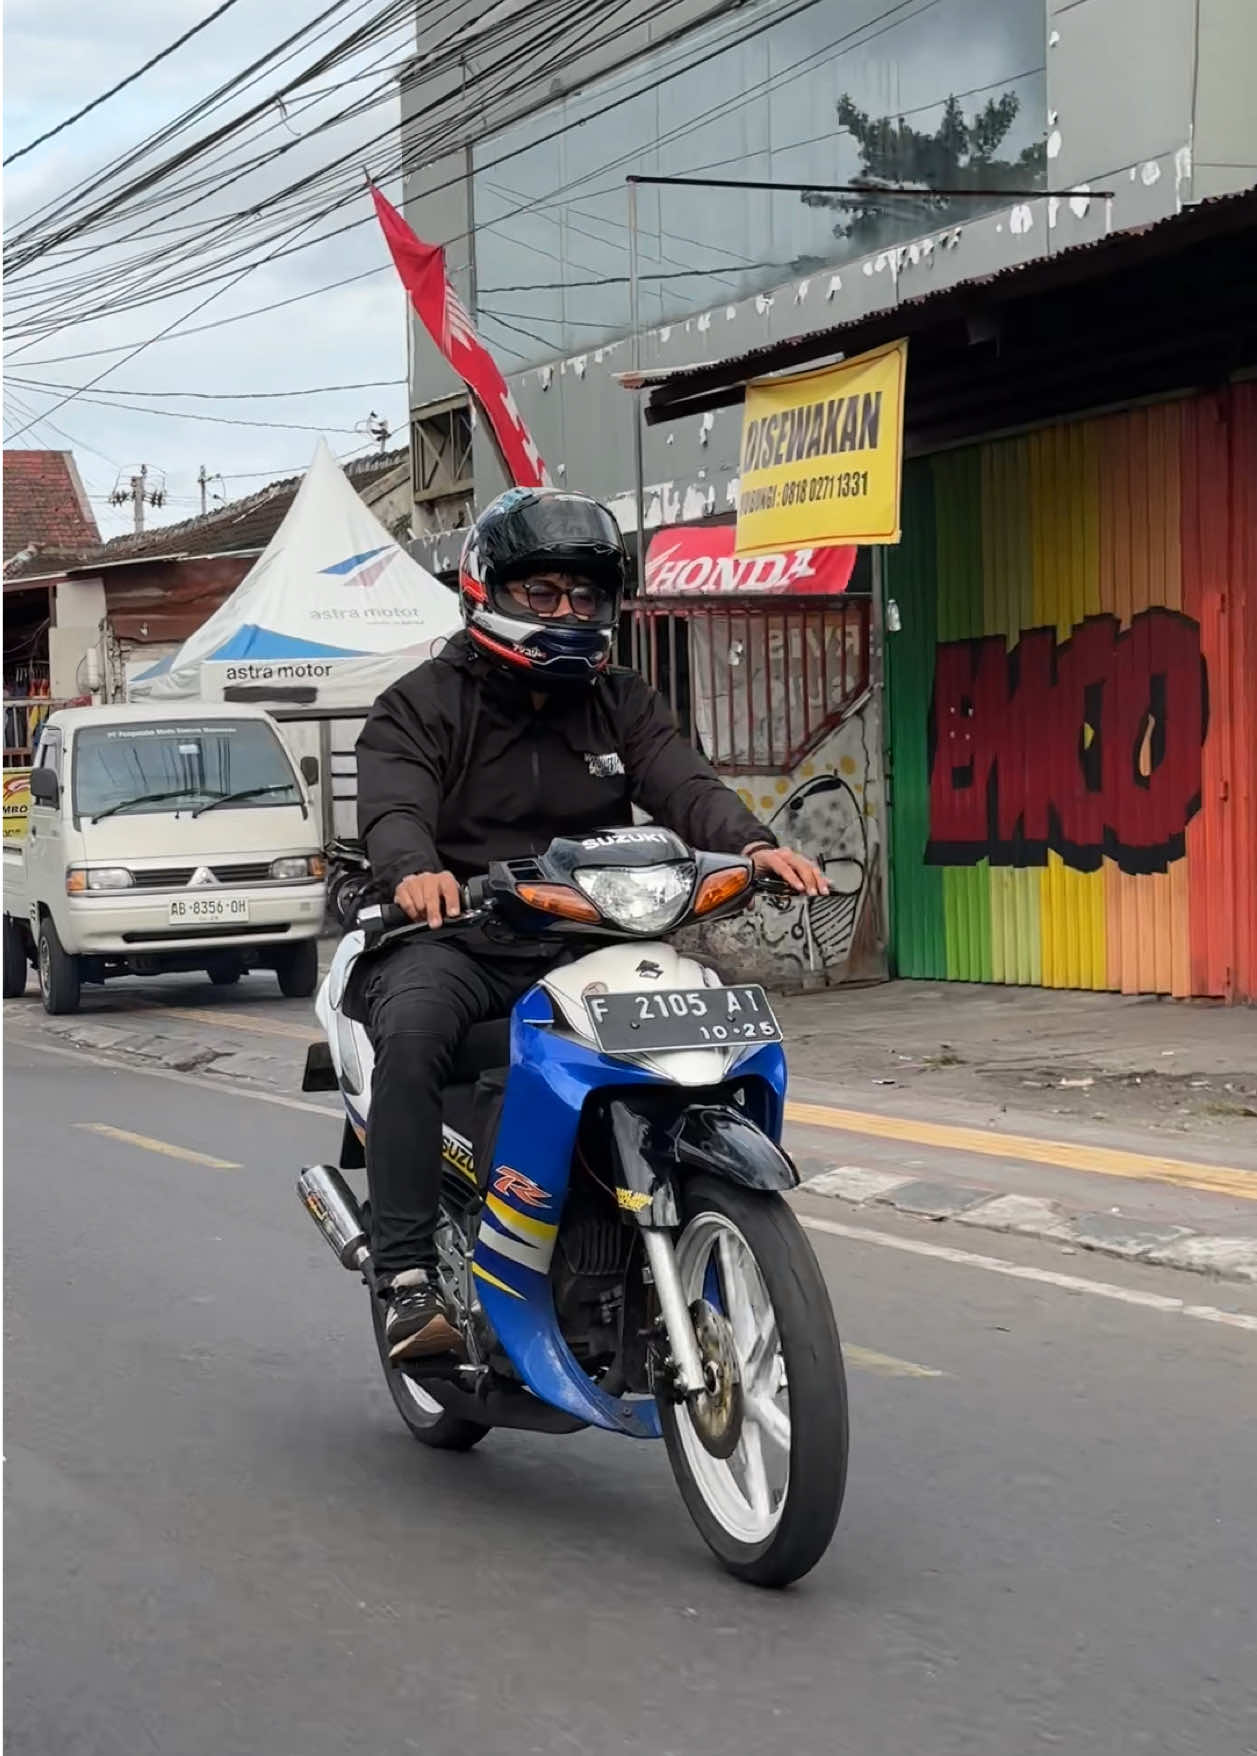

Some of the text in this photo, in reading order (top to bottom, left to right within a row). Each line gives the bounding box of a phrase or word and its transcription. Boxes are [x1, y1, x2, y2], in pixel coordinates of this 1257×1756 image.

[743, 391, 883, 473] DISEWAKAN
[782, 480, 807, 507] 0818
[809, 476, 834, 502] 0271
[837, 471, 868, 498] 1331
[650, 548, 816, 593] HONDA
[364, 606, 419, 618] motor
[226, 663, 333, 680] astra motor
[582, 833, 668, 850] SUZUKI
[171, 901, 186, 916] AB
[590, 999, 608, 1023] F
[635, 993, 708, 1020] 2105
